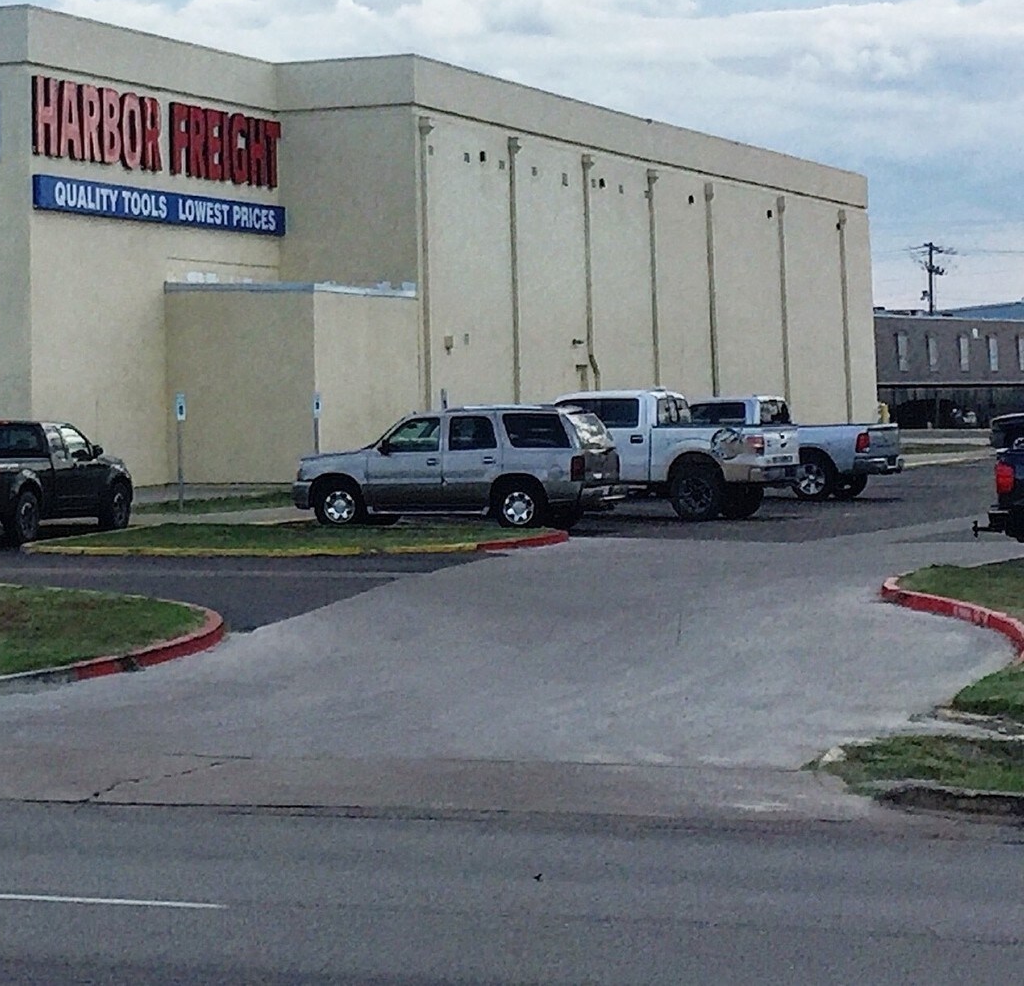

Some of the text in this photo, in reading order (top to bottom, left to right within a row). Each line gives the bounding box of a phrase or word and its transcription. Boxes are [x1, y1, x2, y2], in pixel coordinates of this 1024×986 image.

[32, 75, 281, 191] HARBOR FREIGHT
[54, 181, 276, 231] QUALITY TOOLS LOWEST PRICES
